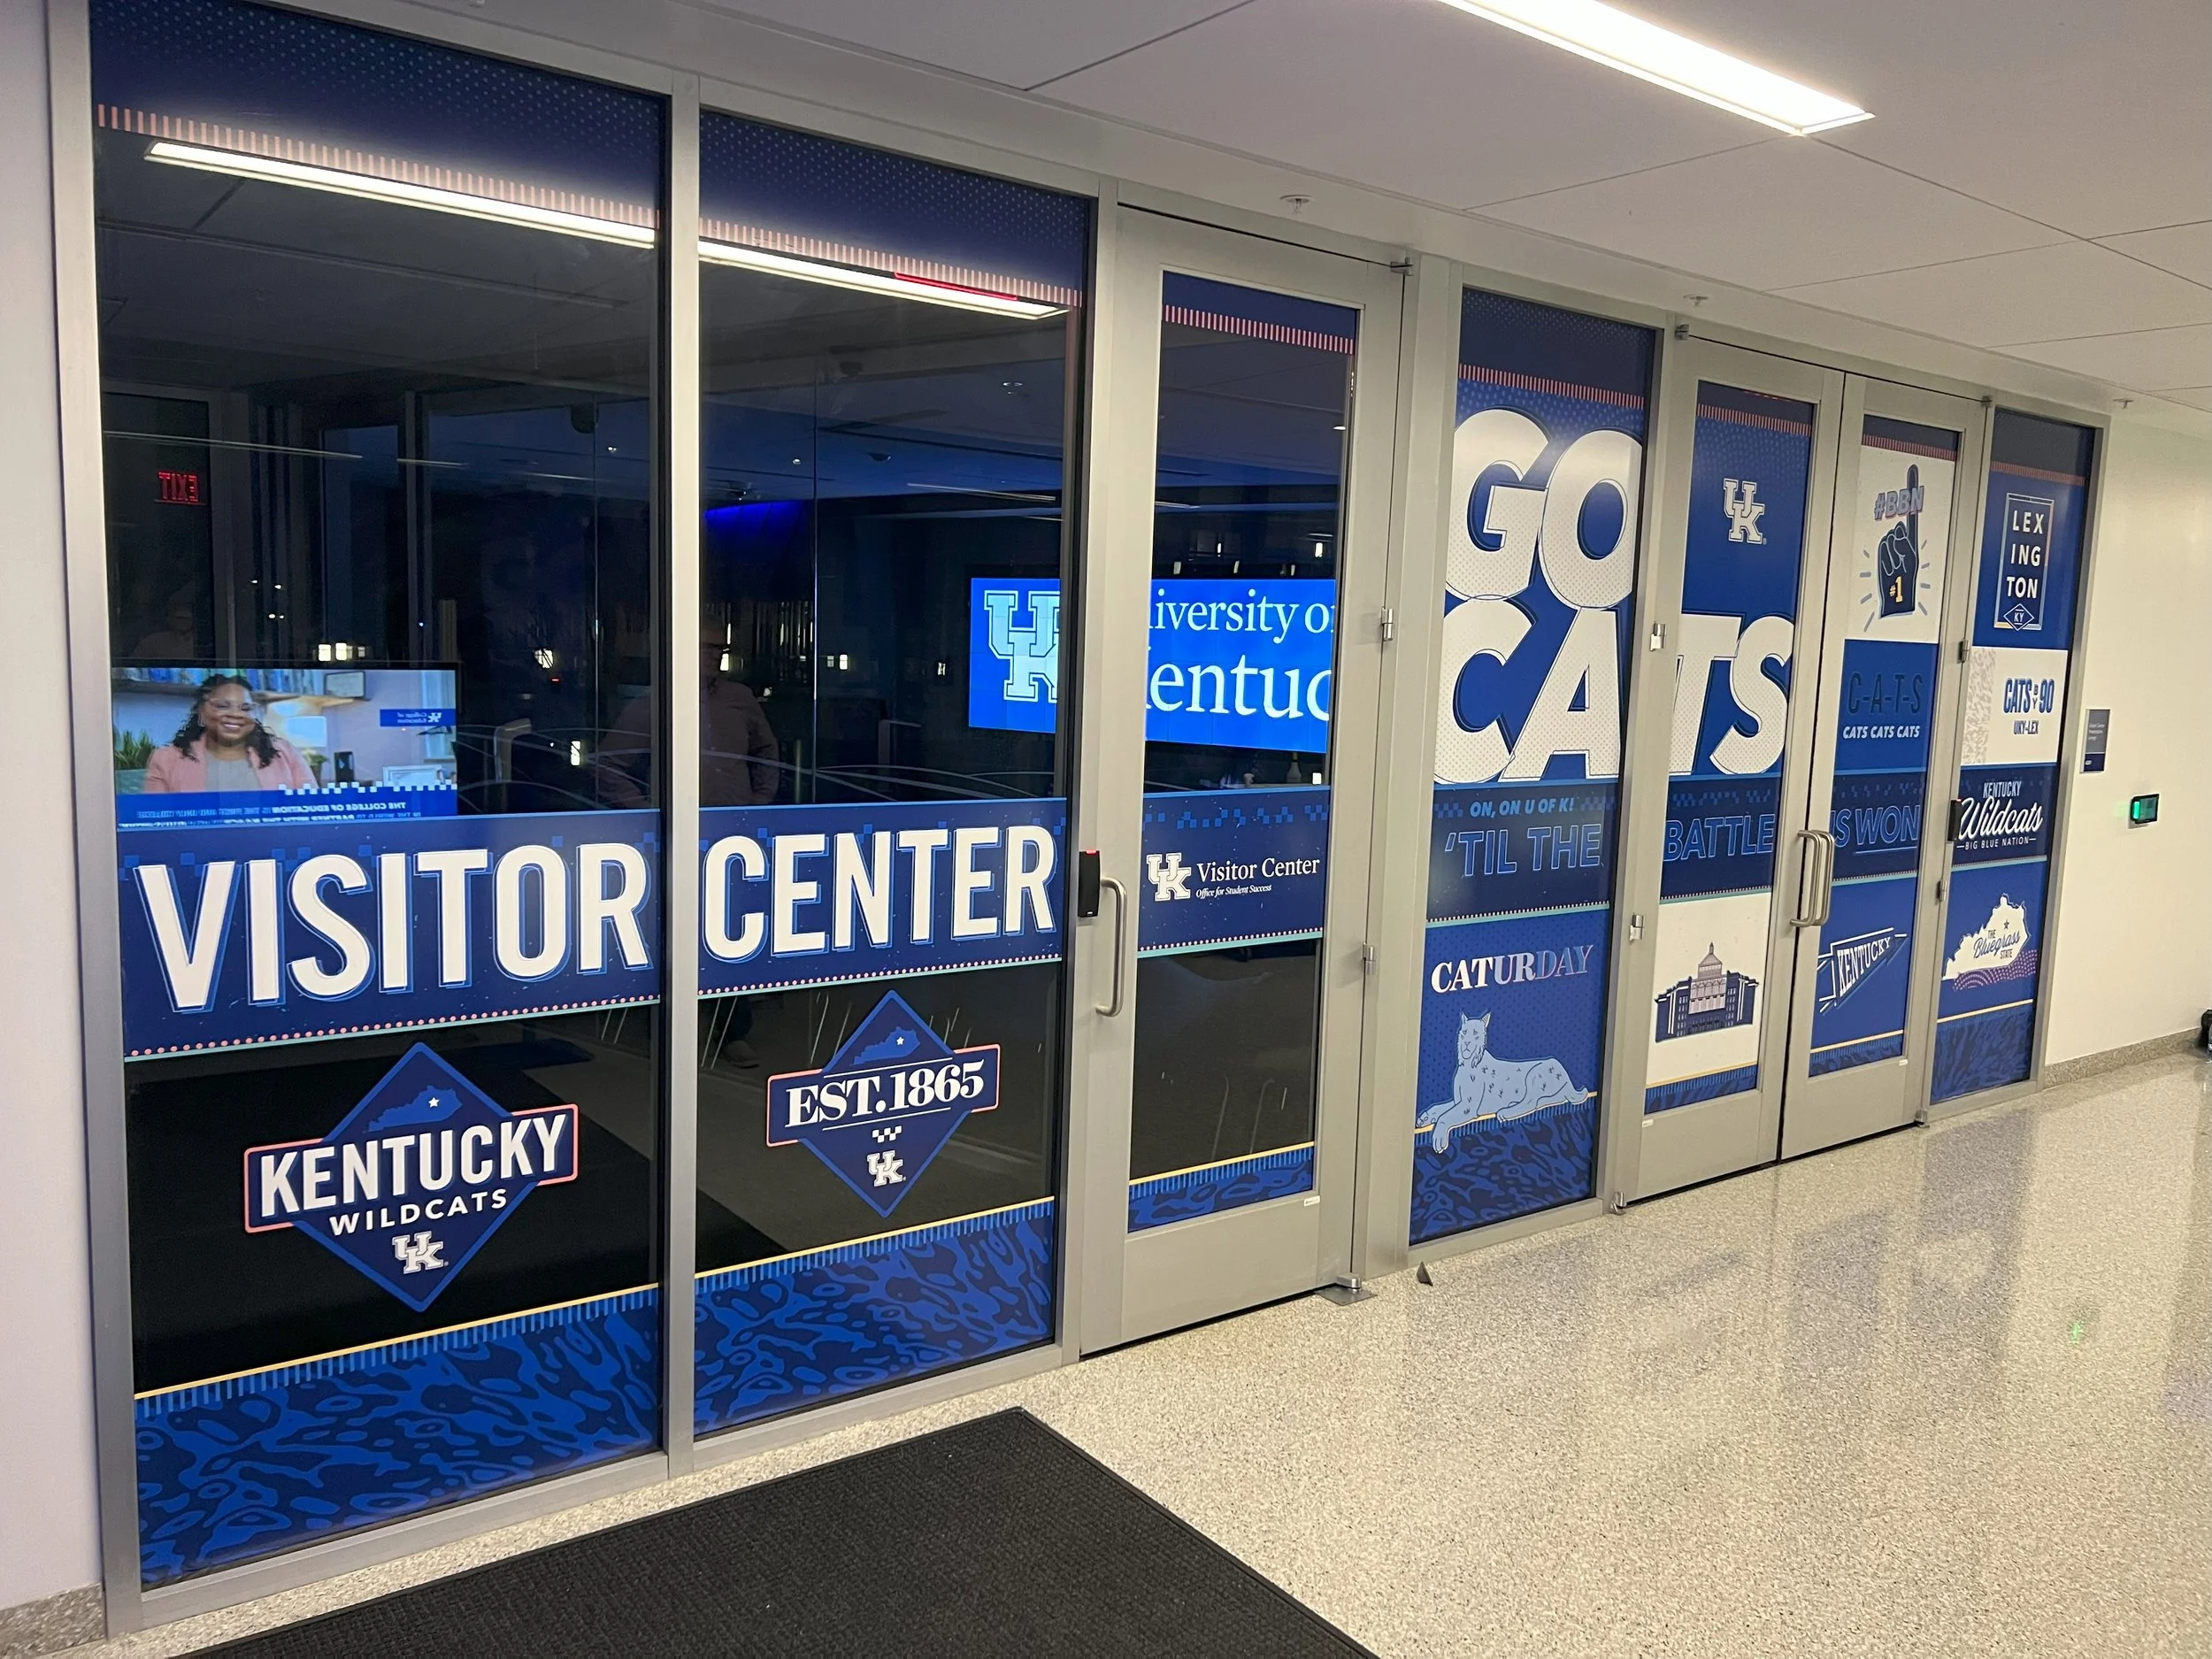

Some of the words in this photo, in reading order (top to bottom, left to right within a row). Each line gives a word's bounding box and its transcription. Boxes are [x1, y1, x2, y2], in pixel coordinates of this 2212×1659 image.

[1446, 409, 1643, 610] GO
[1874, 486, 1924, 521] #BBN
[2012, 510, 2045, 534] LEX
[2010, 543, 2041, 567] ING
[1889, 576, 1903, 603] #1
[2007, 576, 2039, 599] TON
[1149, 588, 1299, 644] iversity
[1305, 603, 1336, 634] o
[2014, 611, 2024, 623] KY
[1146, 654, 1332, 721] entuc
[1848, 672, 1923, 714] C-A-T-S
[2003, 678, 2032, 713] CATS
[2039, 679, 2055, 713] 90
[1843, 726, 1869, 739] CATS
[1870, 726, 1894, 738] CATS
[1896, 726, 1920, 738] CATS
[1983, 780, 2022, 798] KENTUCKY
[1470, 801, 1495, 818] ON,
[1499, 800, 1521, 815] ON
[1525, 799, 1535, 814] U
[1538, 798, 1557, 813] OF
[1559, 797, 1575, 811] K!
[1958, 796, 2043, 840] Wildcats
[1445, 829, 1517, 877] 'TIL
[1527, 824, 1601, 872] THE
[1663, 814, 1776, 862] BATTLE
[1855, 805, 1920, 845] WON
[1965, 841, 1978, 849] BIG
[1981, 839, 1999, 849] BLUE
[2001, 836, 2029, 846] NATION
[1196, 860, 1257, 883] Visitor
[1262, 857, 1320, 878] Center
[1195, 887, 1214, 898] Office
[1215, 887, 1225, 898] for
[1225, 885, 1249, 895] Student
[1249, 884, 1272, 893] Success
[134, 842, 652, 1012] VISITOR
[705, 825, 1057, 961] CENTER
[1973, 931, 2021, 959] Bluegrass
[1431, 944, 1594, 994] CATURDAY
[1836, 936, 1892, 997] KENTUCKY
[260, 1113, 566, 1218] KENTUCKY
[328, 1188, 507, 1236] WILDCATS
